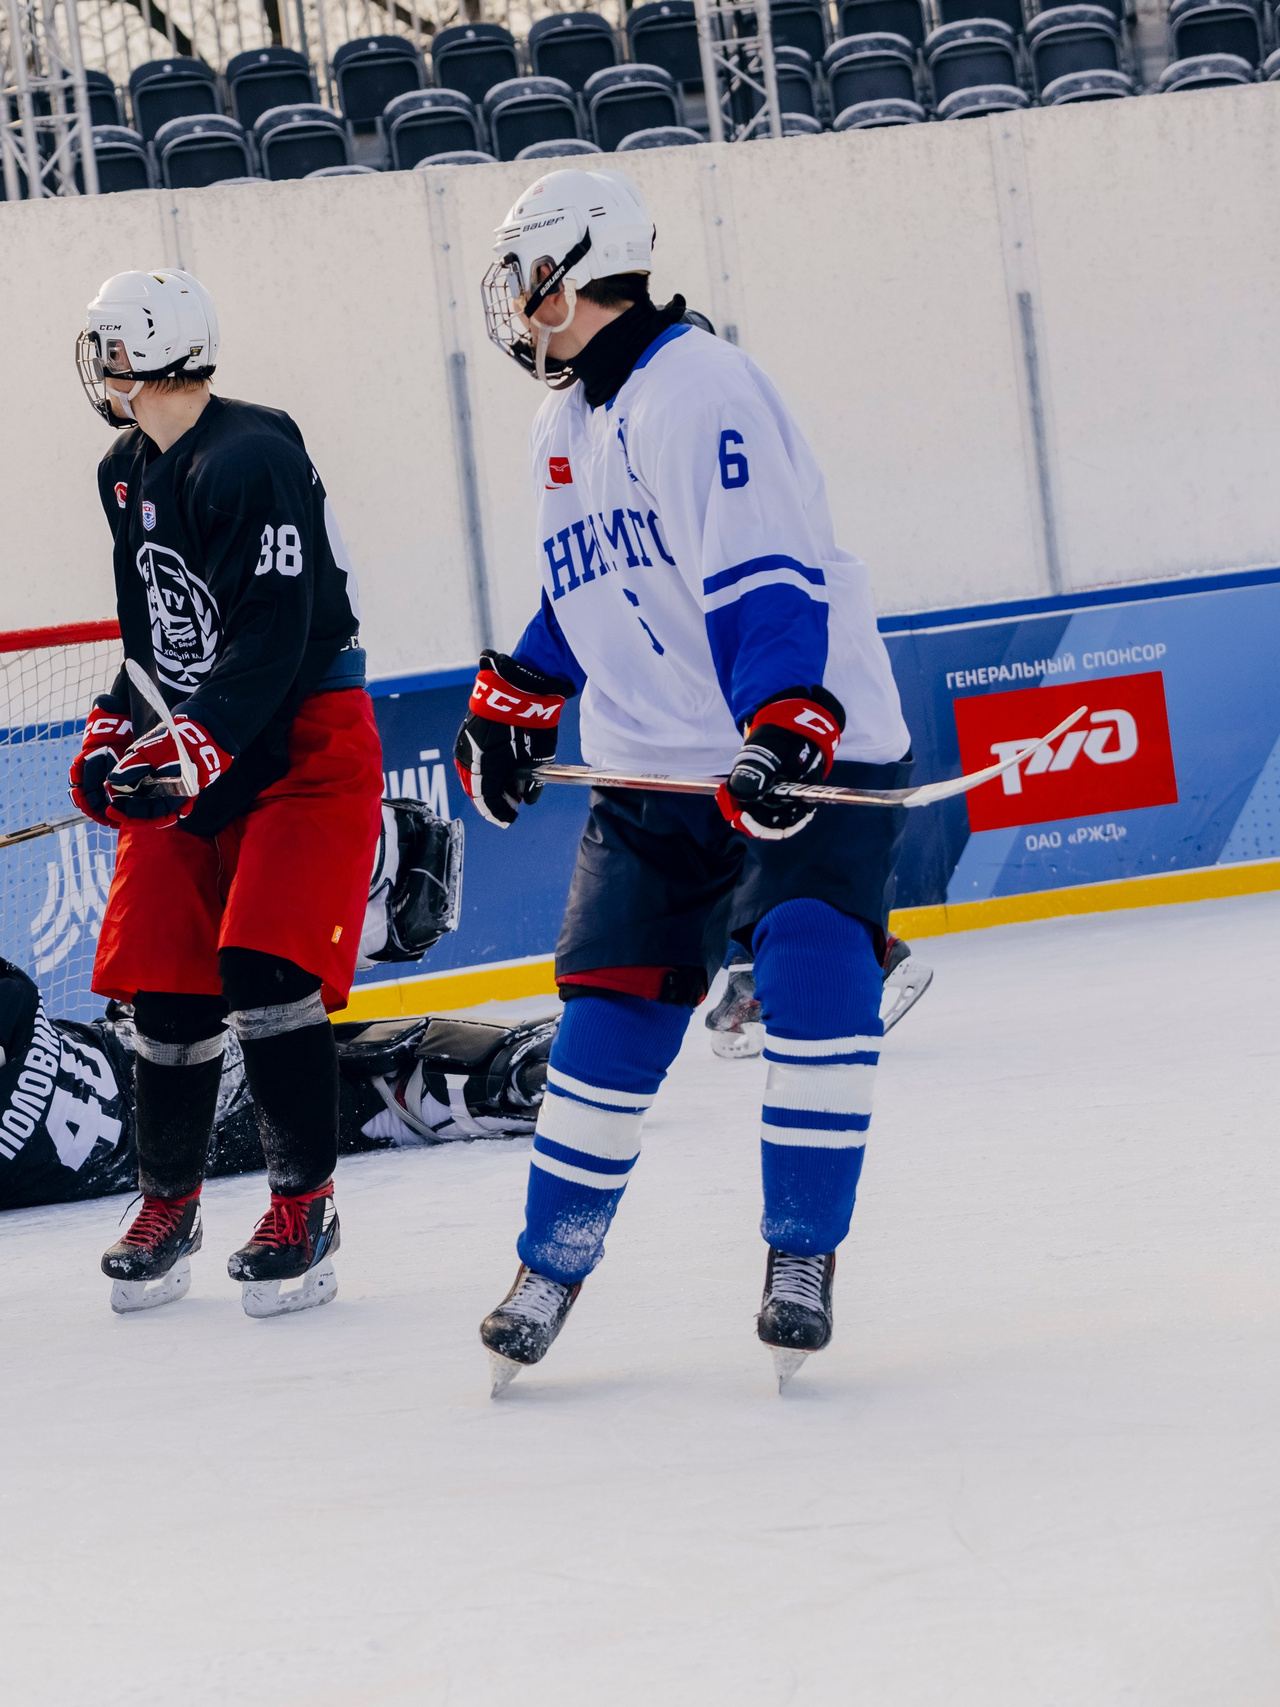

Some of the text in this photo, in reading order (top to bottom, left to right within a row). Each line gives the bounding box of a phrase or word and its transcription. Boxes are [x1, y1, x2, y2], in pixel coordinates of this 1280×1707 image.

[522, 216, 565, 232] BAUER
[540, 265, 566, 297] BAUER
[718, 429, 749, 490] 6
[946, 643, 1167, 689] ГЕНЕРАЛЬНЫЙ СПОНСОР
[473, 679, 562, 721] CCM
[1025, 823, 1128, 852] ОАО «РЖД»
